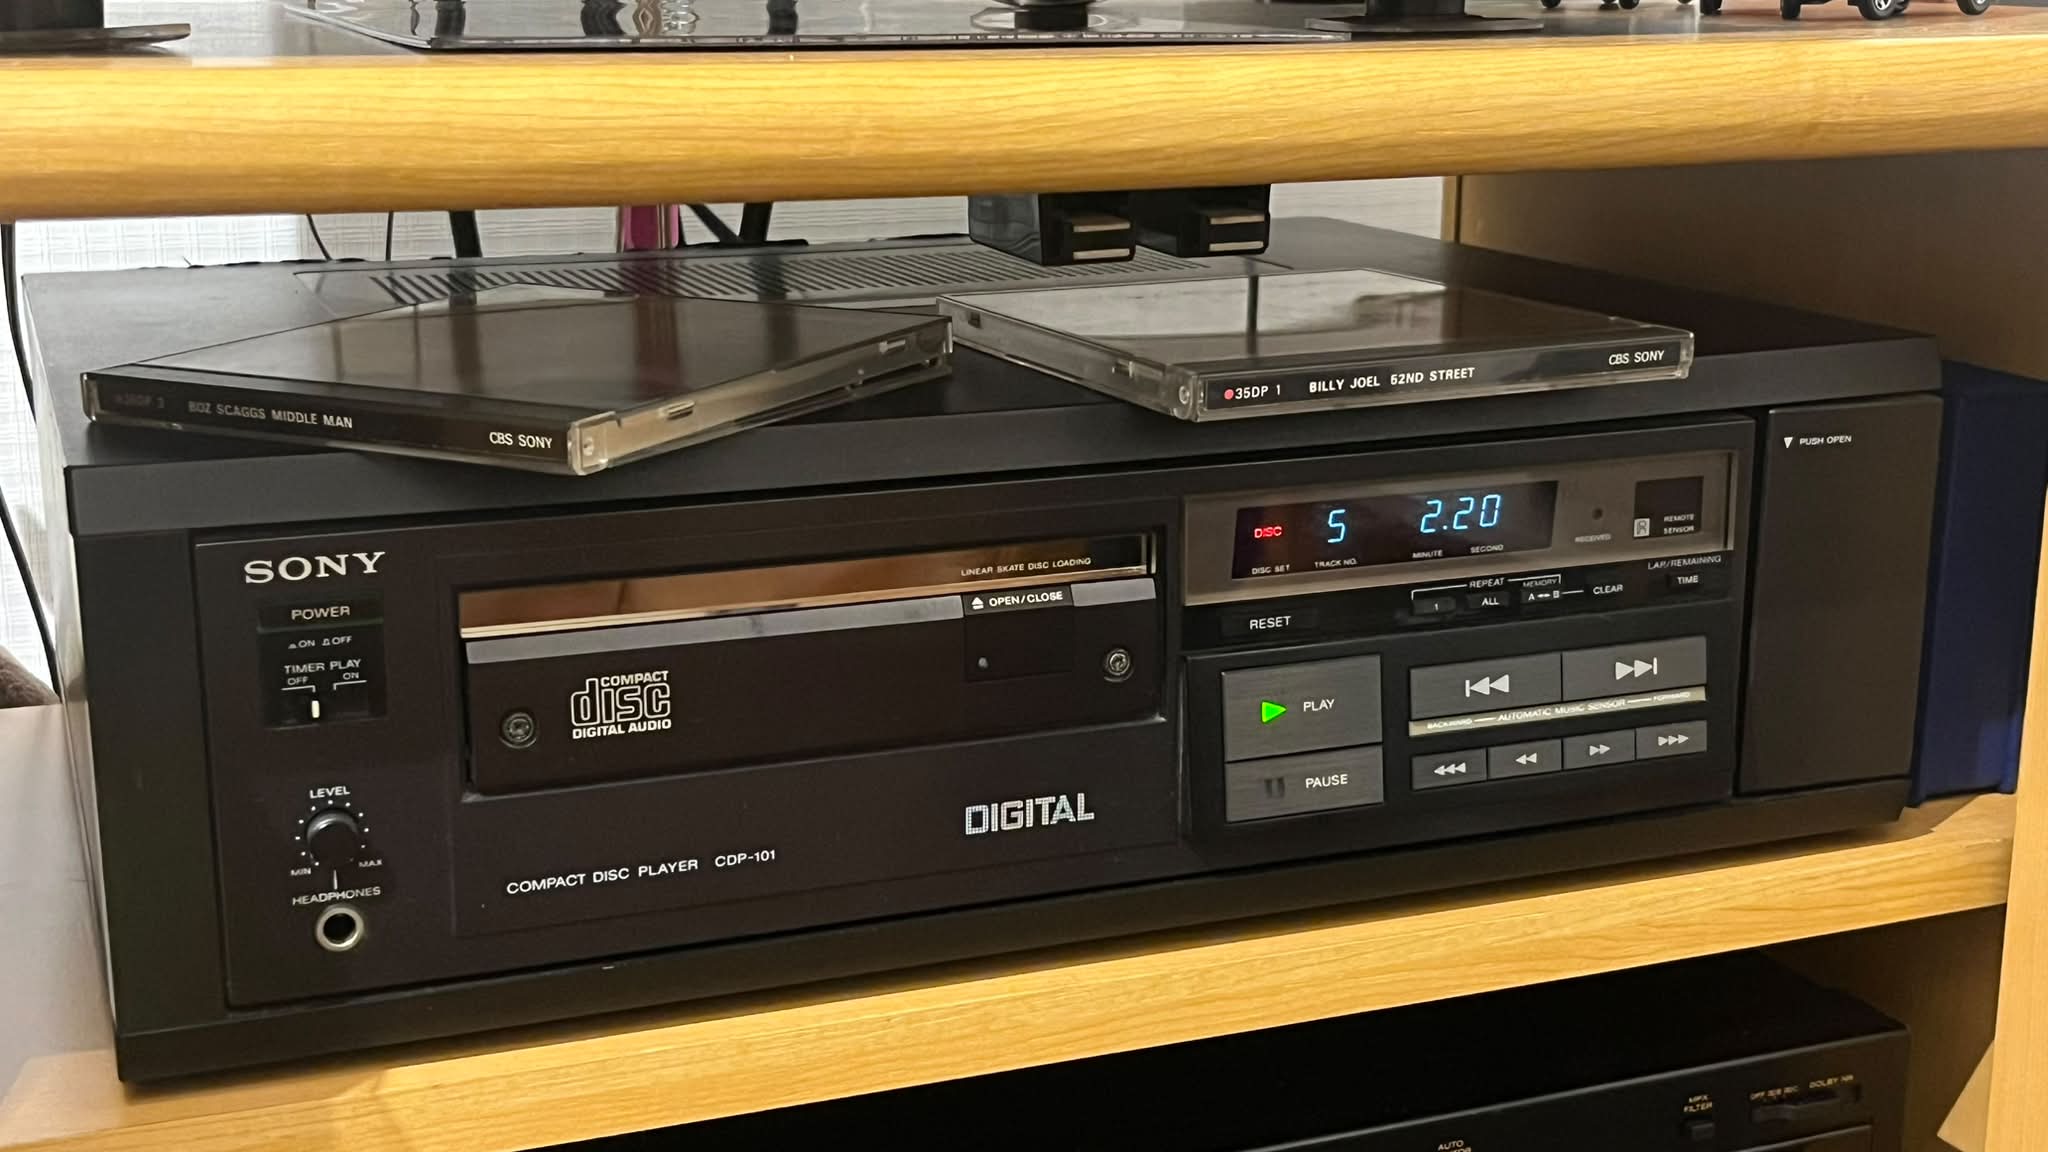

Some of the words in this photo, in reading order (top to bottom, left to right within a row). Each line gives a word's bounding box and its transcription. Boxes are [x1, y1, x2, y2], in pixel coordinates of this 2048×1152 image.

[1608, 353, 1630, 366] CBS
[1634, 350, 1665, 363] SONY
[1235, 386, 1268, 400] 35DP
[1276, 384, 1281, 396] 1
[1309, 379, 1345, 393] BILLY
[1350, 375, 1380, 389] JOEL
[1429, 367, 1475, 382] STREET
[188, 400, 212, 414] BOZ
[215, 403, 266, 420] SCAGGS
[271, 409, 318, 425] MIDDLE
[323, 414, 353, 429] MAN
[489, 431, 513, 446] CBS
[518, 434, 552, 449] SONY
[1799, 437, 1824, 446] PUSH
[1826, 435, 1852, 444] OPEN
[1419, 493, 1501, 533] 2.20
[1663, 513, 1695, 523] REMOTE
[1253, 525, 1282, 538] DISC
[1327, 508, 1346, 544] 5
[1663, 525, 1695, 535] SENSOR
[1412, 549, 1443, 559] MINUTE
[1470, 543, 1504, 554] SECOND
[244, 551, 386, 584] SONY
[960, 565, 994, 577] LINEAR
[996, 563, 1025, 574] SKATE
[1027, 560, 1049, 571] DISC
[1052, 557, 1091, 568] LOADING
[1251, 566, 1272, 576] DISC
[1274, 564, 1291, 574] SET
[1314, 559, 1341, 569] TRACK
[1469, 577, 1505, 589] REPEAT
[1522, 577, 1557, 588] MEMORY
[1677, 574, 1699, 585] TIME
[1528, 592, 1536, 601] A
[1592, 584, 1624, 595] CLEAR
[989, 590, 1064, 607] OPEN/CLOSE
[1481, 597, 1499, 606] ALL
[291, 605, 351, 621] POWER
[1249, 615, 1292, 631] RESET
[298, 639, 316, 649] ON
[331, 635, 353, 645] OFF
[283, 662, 325, 675] TIMER
[329, 659, 362, 671] PLAY
[287, 676, 309, 686] OFF
[342, 672, 360, 681] ON
[600, 670, 669, 688] COMPACT
[570, 678, 671, 726] disc
[1303, 699, 1335, 712] PLAY
[1495, 707, 1552, 722] AUTOMATIC
[1554, 703, 1585, 715] MUSIC
[1587, 699, 1626, 712] SENSOR
[572, 723, 625, 740] DIGITAL
[628, 718, 672, 734] AUDIO
[1305, 773, 1349, 789] PAUSE
[309, 785, 351, 799] LEVEL
[965, 792, 1095, 836] DIGITAL
[358, 859, 383, 868] MAX
[290, 867, 312, 877] MIN
[506, 872, 586, 895] COMPACT
[592, 867, 630, 885] DISC
[638, 858, 699, 878] PLAYER
[714, 849, 776, 869] CDP-101
[292, 886, 382, 906] HEADPHONES
[1437, 1139, 1465, 1151] AUTO
